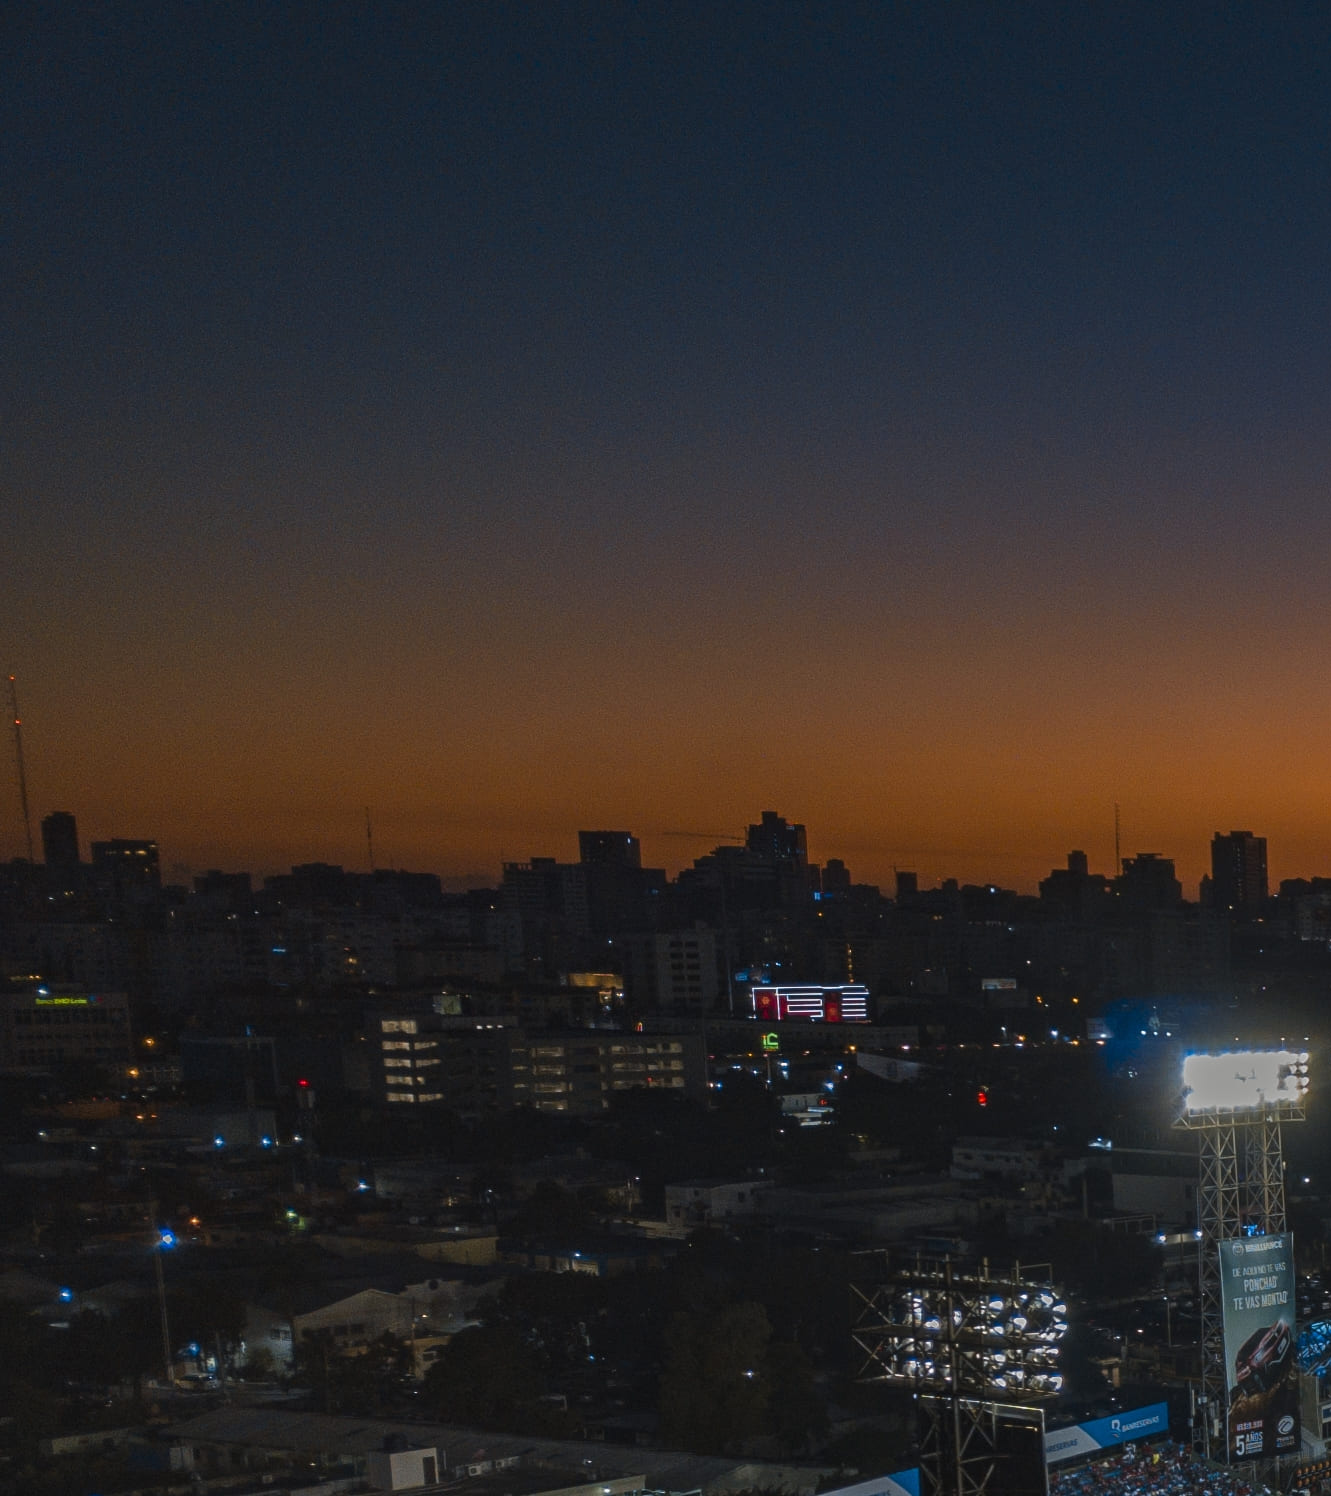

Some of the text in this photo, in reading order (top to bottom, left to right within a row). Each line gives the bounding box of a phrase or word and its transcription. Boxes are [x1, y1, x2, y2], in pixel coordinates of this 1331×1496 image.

[1233, 1297, 1243, 1311] TE
[1245, 1295, 1260, 1309] VAS
[1235, 1434, 1245, 1456] 5
